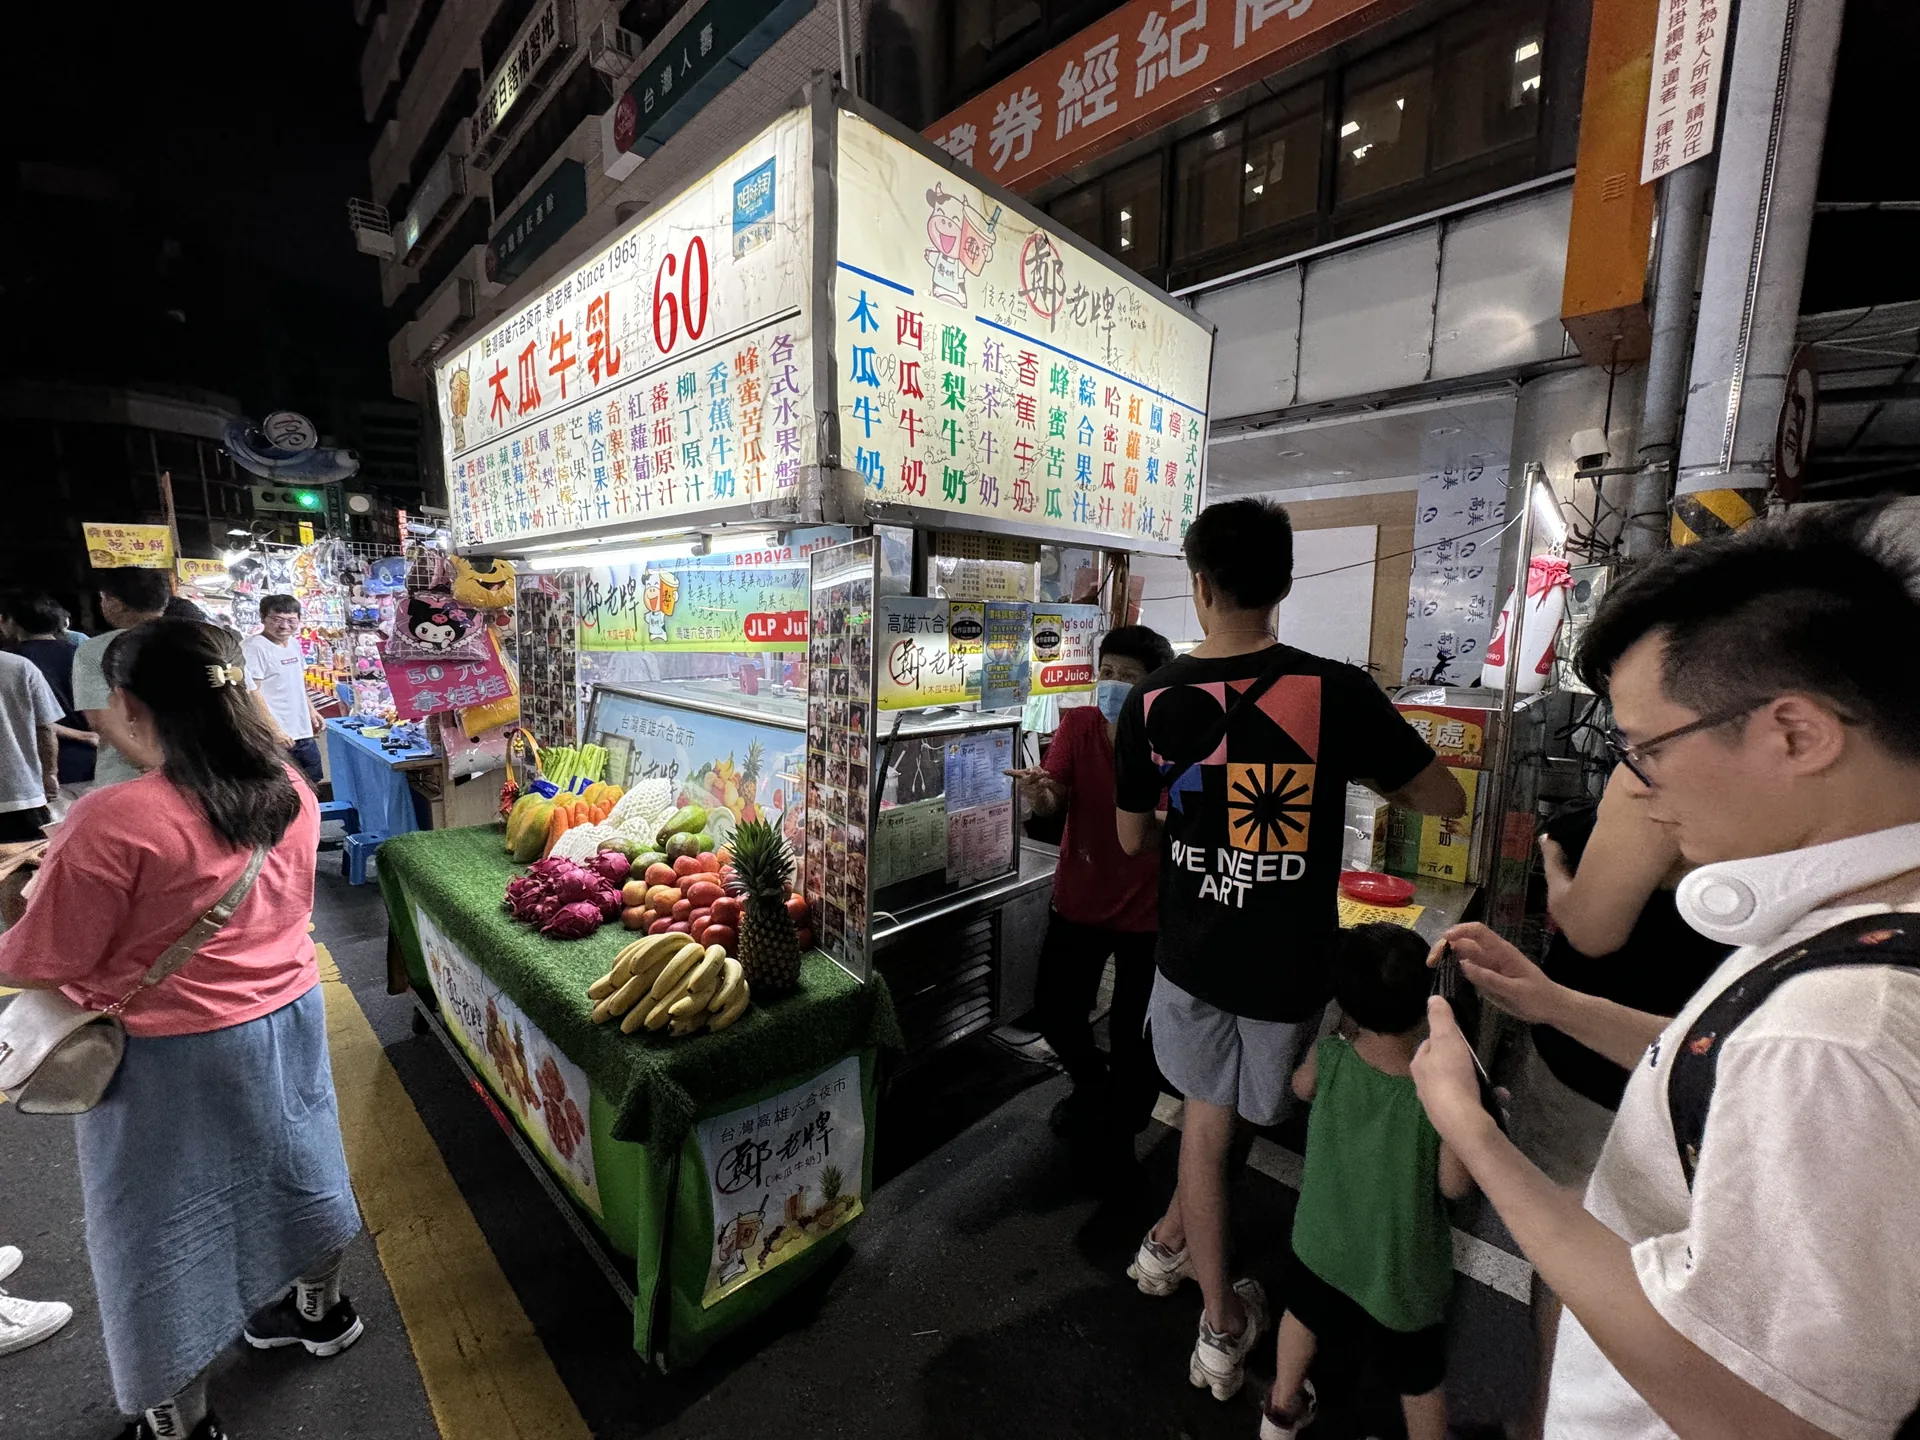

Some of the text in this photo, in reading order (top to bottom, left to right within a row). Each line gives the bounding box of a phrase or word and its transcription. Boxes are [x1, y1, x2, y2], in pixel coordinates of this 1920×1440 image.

[643, 21, 714, 115] 台灣人壽
[577, 264, 605, 293] Since
[608, 233, 637, 273] 1965
[652, 235, 709, 354] 60
[1018, 231, 1117, 365] 鄭老牌
[488, 290, 621, 429] 木瓜牛乳
[847, 289, 885, 491] 木瓜牛奶
[896, 306, 927, 497] 西瓜牛奶
[606, 400, 631, 514] 奇異果汁
[628, 391, 653, 511] 紅蘿蔔汁
[648, 381, 677, 507] 蕃茄原汁
[676, 371, 704, 503] 柳丁原汁
[706, 361, 736, 500] 香蕉牛奶
[734, 346, 767, 494] 蜂蜜苦瓜汁
[768, 333, 801, 490] 各式水果盤
[941, 323, 968, 505] 酪梨牛奶
[979, 336, 1005, 508] 紅茶牛奶
[1012, 349, 1039, 513] 香蕉牛奶
[1044, 362, 1069, 519] 蜂蜜苦瓜
[1073, 374, 1096, 523] 綜合果汁
[1098, 386, 1121, 527] 哈密瓜汁
[1121, 393, 1145, 529] 紅蘿蔔汁
[467, 460, 483, 541] 西瓜牛乳
[477, 456, 494, 538] 酪梨牛乳
[486, 453, 502, 533] 綠豆沙牛奶
[499, 446, 517, 533] 蘋果牛奶
[511, 439, 530, 530] 草莓牛奶
[524, 435, 544, 528] 紅茶牛奶
[539, 428, 558, 527] 鳳梨汁
[553, 423, 574, 525] 現榨檸檬汁
[569, 416, 591, 521] 芒果汁
[588, 408, 611, 519] 綜合果汁
[1142, 404, 1163, 534] 鳳梨汁
[580, 572, 640, 634] 鄭老牌
[735, 545, 792, 566] papaya
[675, 625, 722, 640] 高雄六合夜市
[747, 617, 777, 637] JLP
[886, 613, 949, 634] 高雄六合
[892, 638, 968, 690] 鄭老牌
[1073, 645, 1092, 658] milk
[1079, 617, 1094, 629] old
[407, 664, 444, 685] 50
[1044, 669, 1090, 684] JLP Juice
[621, 712, 696, 748] 台灣高雄六合夜市
[1169, 834, 1306, 882] WE NEED
[1198, 874, 1253, 908] ART
[718, 1110, 835, 1189] 鄭老牌
[720, 1077, 847, 1145] 台灣高雄六合夜市
